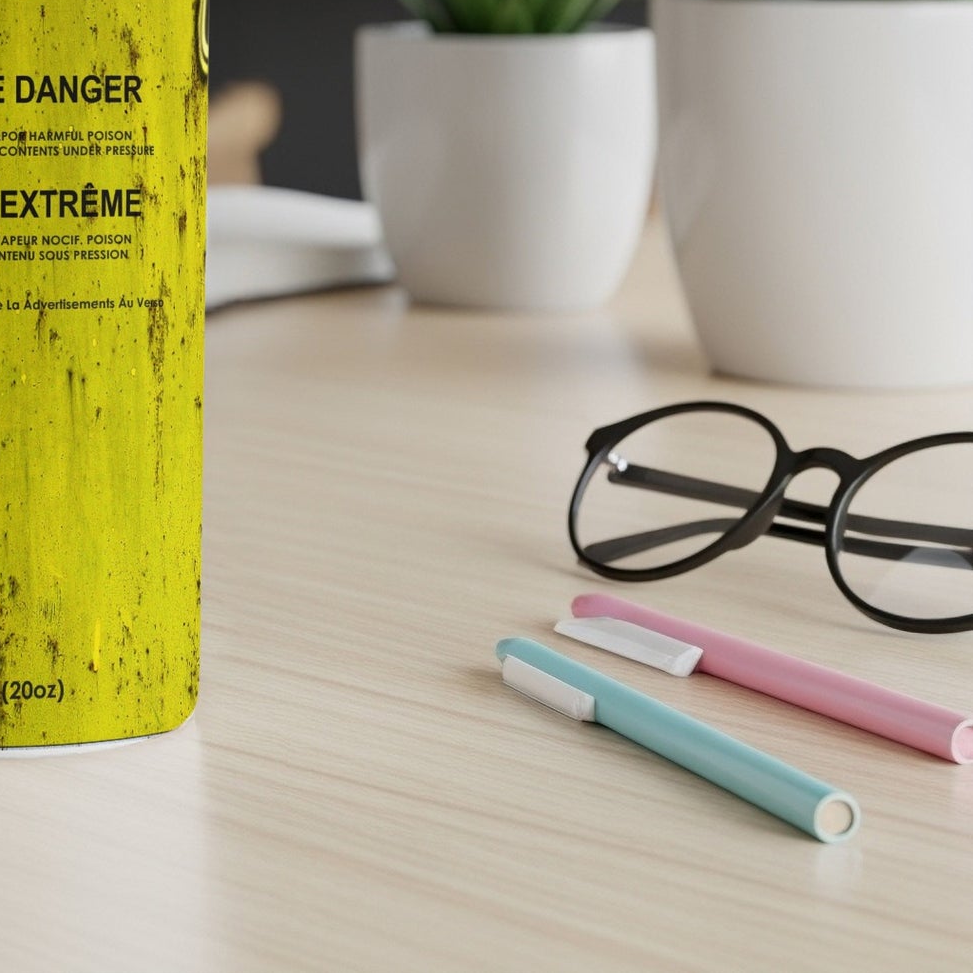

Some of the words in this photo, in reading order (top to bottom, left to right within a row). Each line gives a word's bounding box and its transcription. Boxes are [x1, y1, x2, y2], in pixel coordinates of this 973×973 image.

[15, 75, 142, 103] DANGER
[29, 131, 84, 142] HARMFUL
[88, 131, 133, 142] POISON
[63, 146, 102, 156] UNDER
[106, 146, 154, 156] PRESSURE
[0, 183, 142, 218] EXTRÊME
[42, 235, 83, 246] NOCIF.
[87, 234, 132, 245] POISON
[39, 250, 70, 261] SOUS
[7, 300, 20, 310] La
[23, 298, 115, 310] Advertisements
[2, 679, 64, 704] (20oz)
